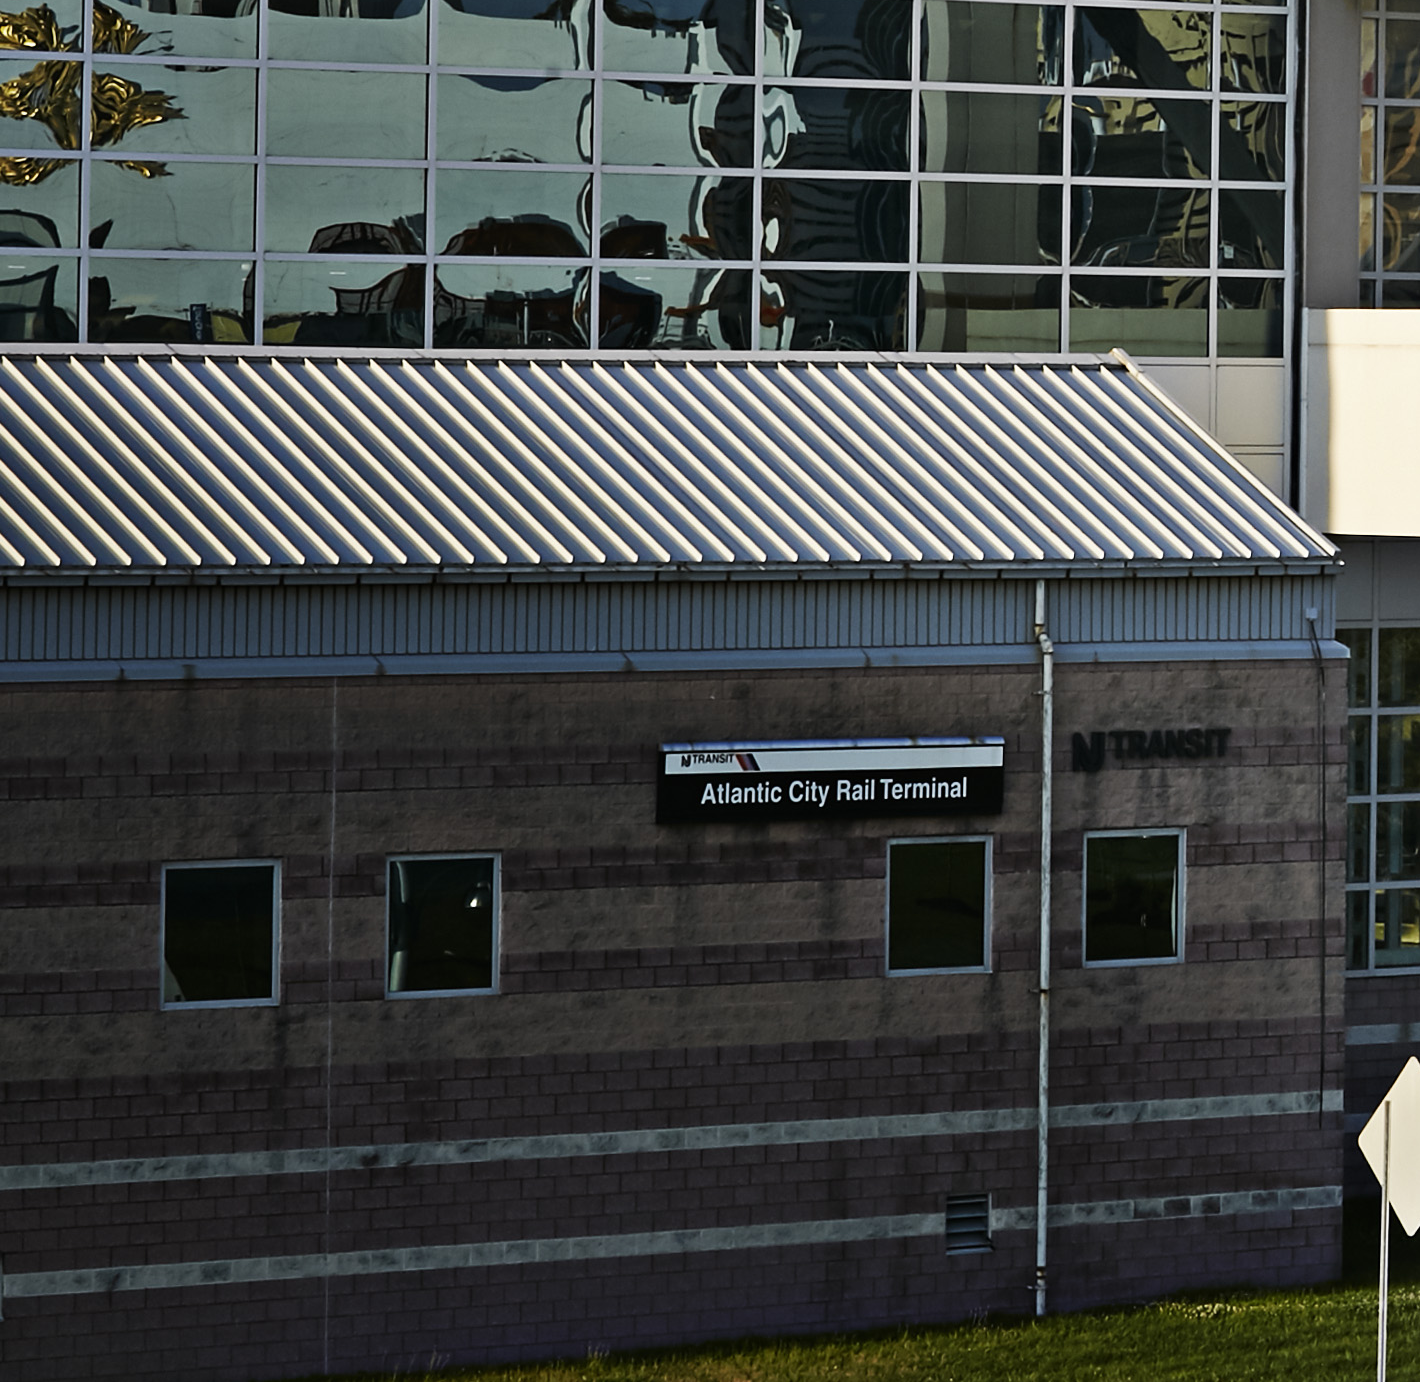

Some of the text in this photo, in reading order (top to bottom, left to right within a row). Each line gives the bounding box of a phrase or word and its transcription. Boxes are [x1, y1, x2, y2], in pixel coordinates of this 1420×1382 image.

[692, 753, 735, 765] TRANSIT
[1108, 728, 1232, 760] TRANSIT
[701, 776, 968, 807] Atlantic City Rail Terminal
